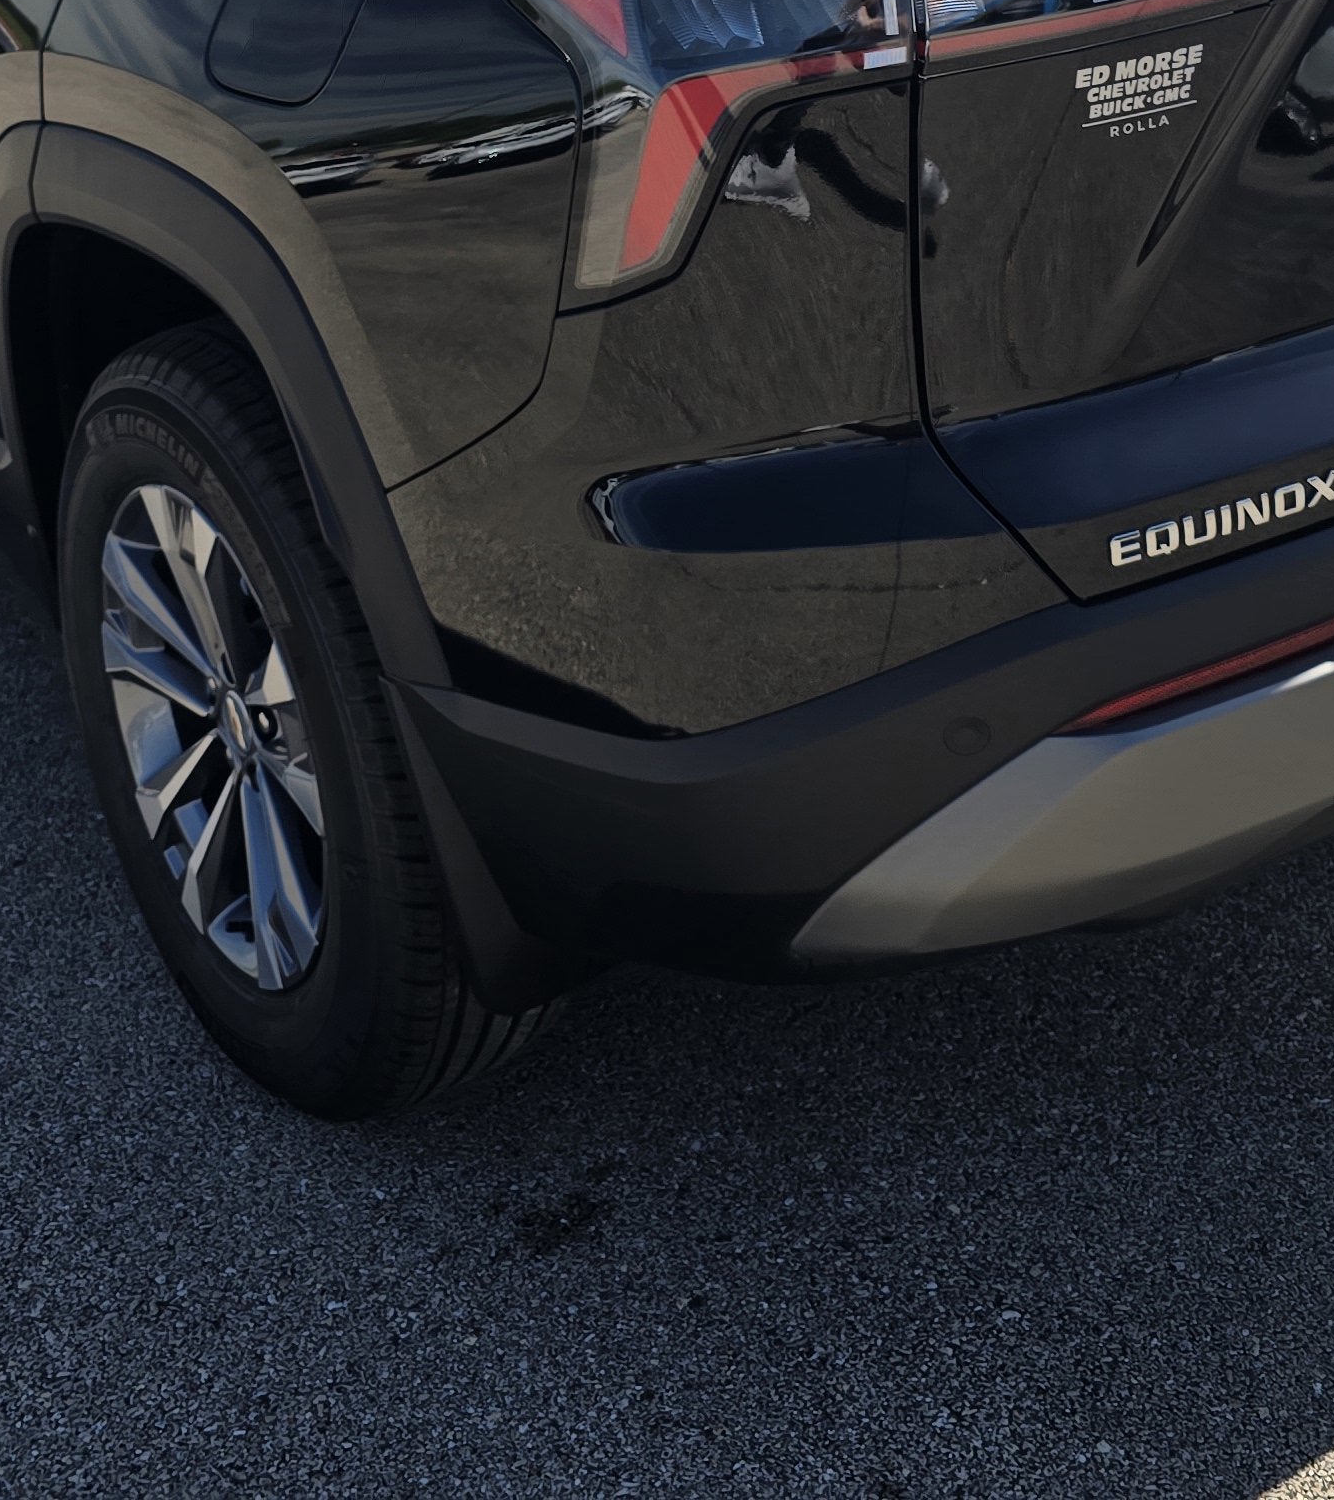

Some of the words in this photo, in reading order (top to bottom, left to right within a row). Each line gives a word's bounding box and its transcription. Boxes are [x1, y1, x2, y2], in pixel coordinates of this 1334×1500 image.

[1075, 65, 1111, 89] ED
[1115, 44, 1204, 82] MORSE
[1087, 67, 1196, 103] CHEVROLET
[1109, 115, 1170, 138] ROLLA
[115, 413, 201, 477] MICHELIN
